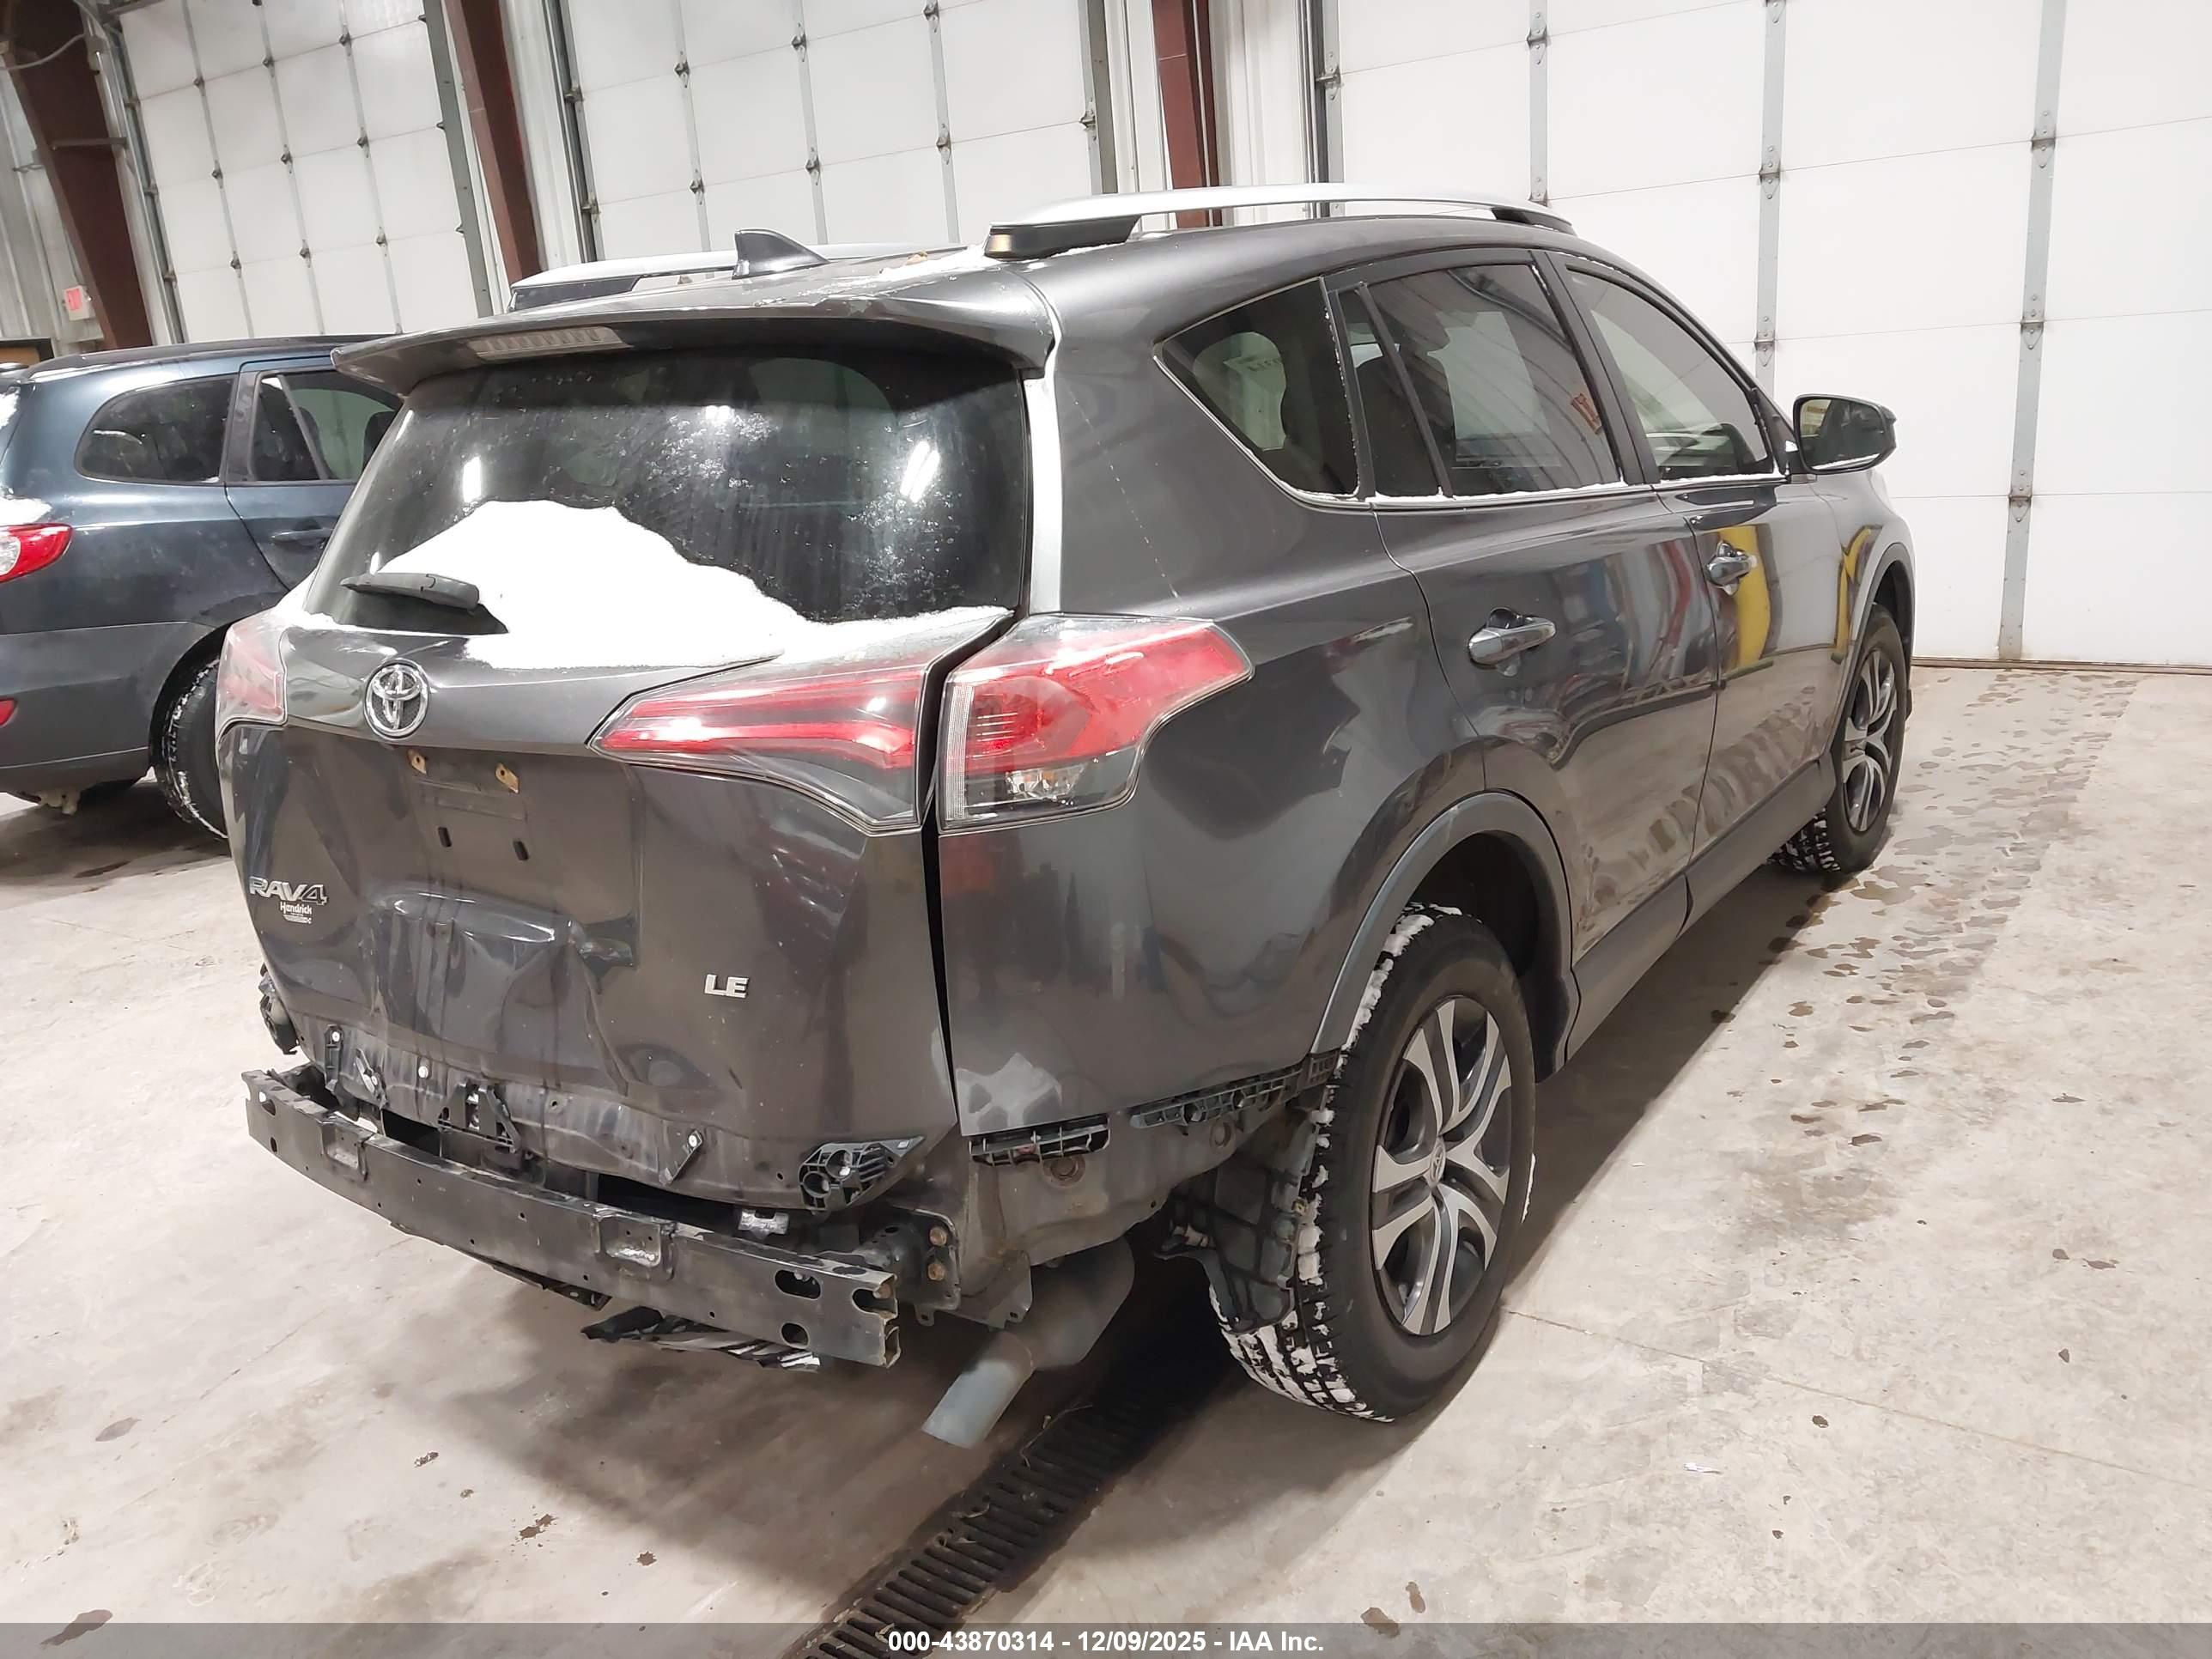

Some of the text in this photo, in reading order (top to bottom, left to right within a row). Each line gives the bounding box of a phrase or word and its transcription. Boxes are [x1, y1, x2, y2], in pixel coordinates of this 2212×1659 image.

[249, 876, 328, 905] RAV4
[280, 902, 313, 915] Hendrick
[704, 974, 750, 999] LE
